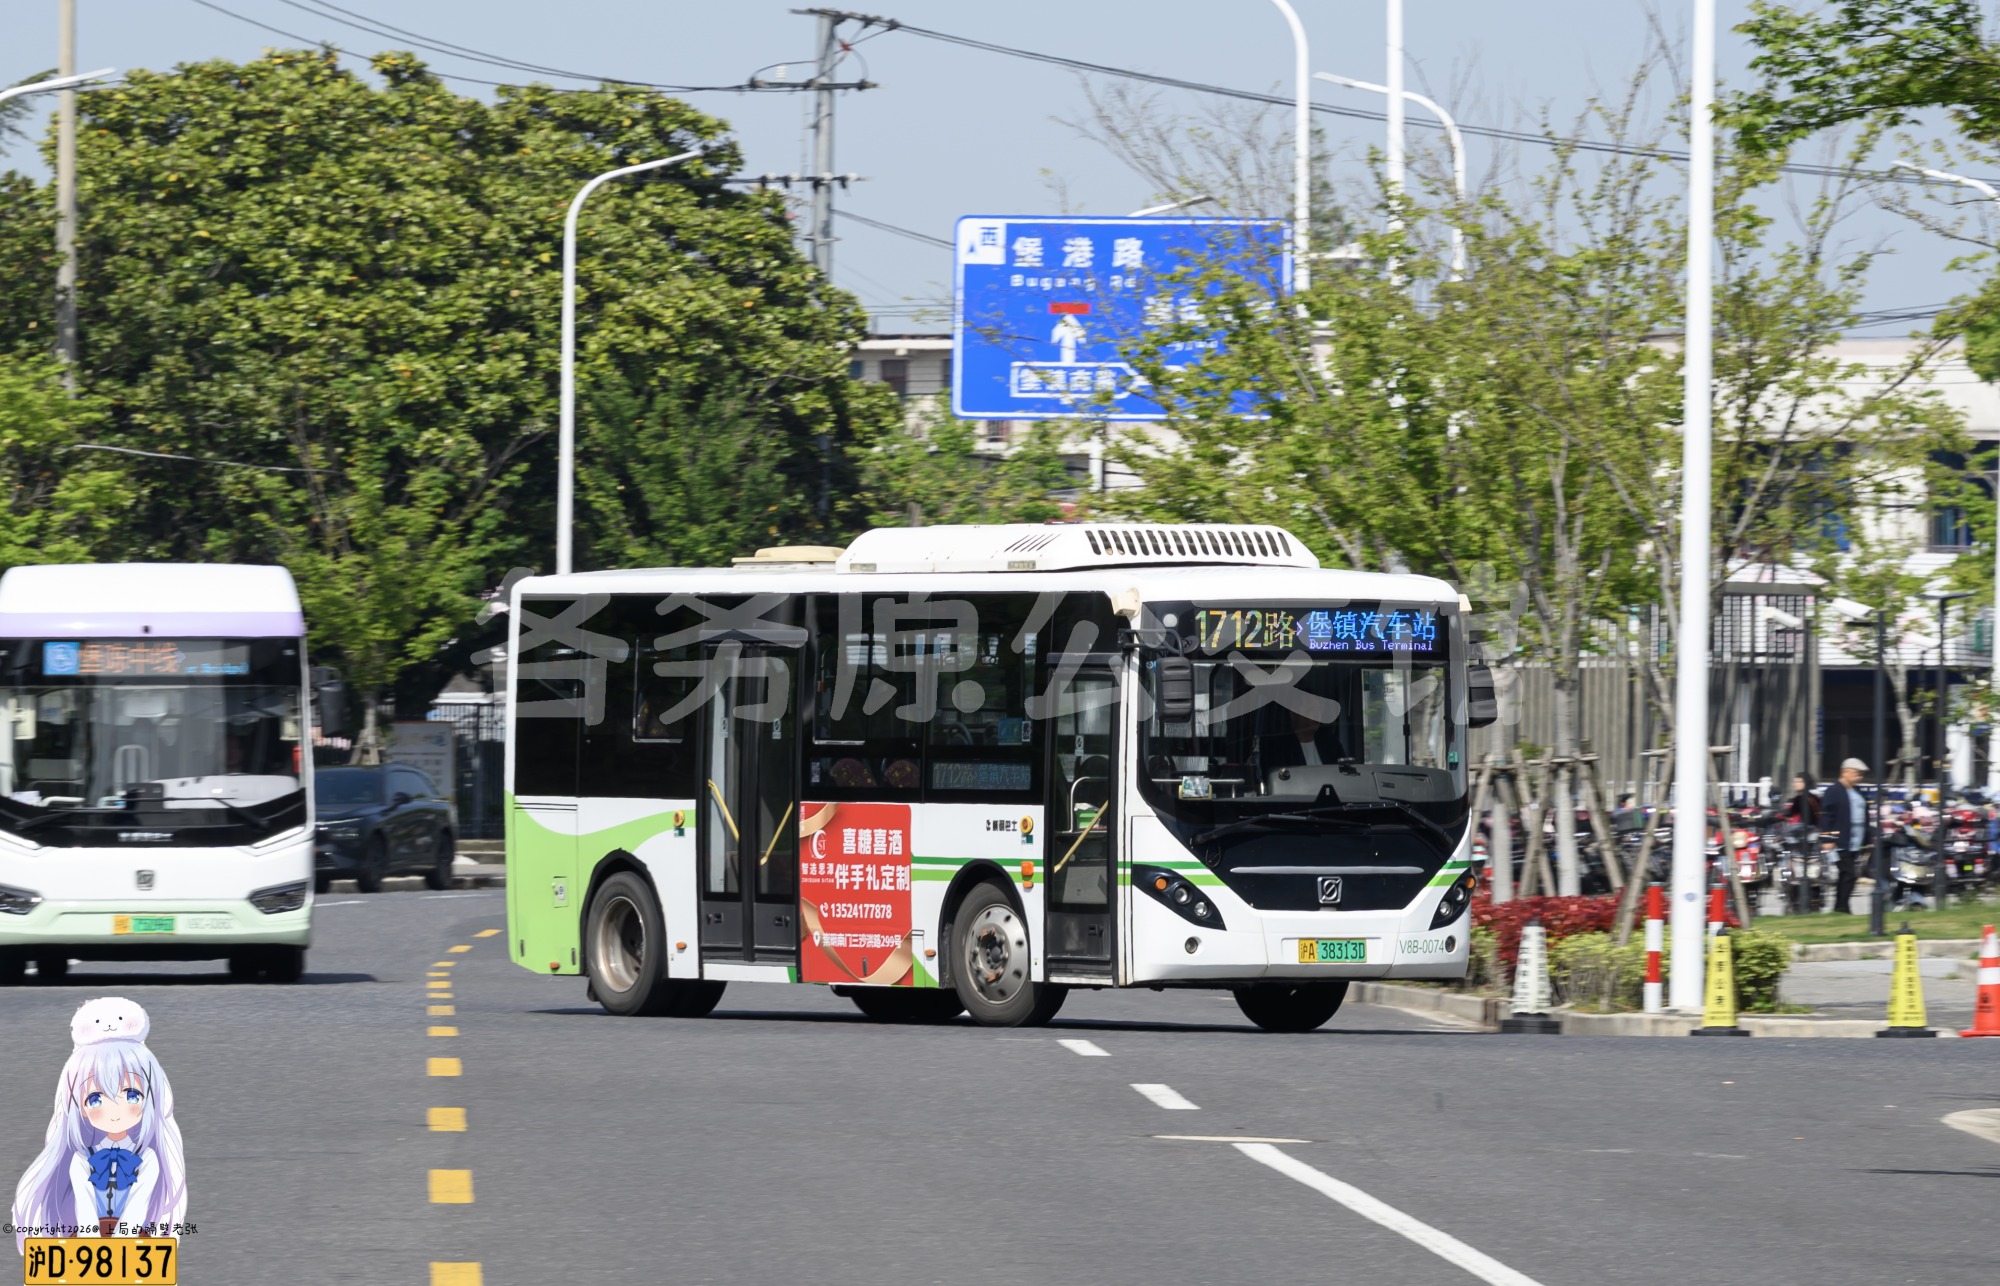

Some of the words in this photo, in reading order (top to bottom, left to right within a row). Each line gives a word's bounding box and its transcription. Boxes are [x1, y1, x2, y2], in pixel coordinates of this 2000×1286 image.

[980, 226, 999, 248] 西
[1011, 236, 1146, 269] 堡港路
[1194, 609, 1296, 650] 1712路
[1306, 609, 1437, 641] 堡镇汽车站
[1308, 639, 1349, 651] Buzhen
[1355, 639, 1375, 651] Bus
[1381, 639, 1434, 651] Terminal
[842, 828, 904, 856] 喜糖喜酒
[834, 863, 912, 891] 伴手礼定制
[830, 903, 893, 919] 13524177878
[1399, 939, 1445, 955] V8B-0074
